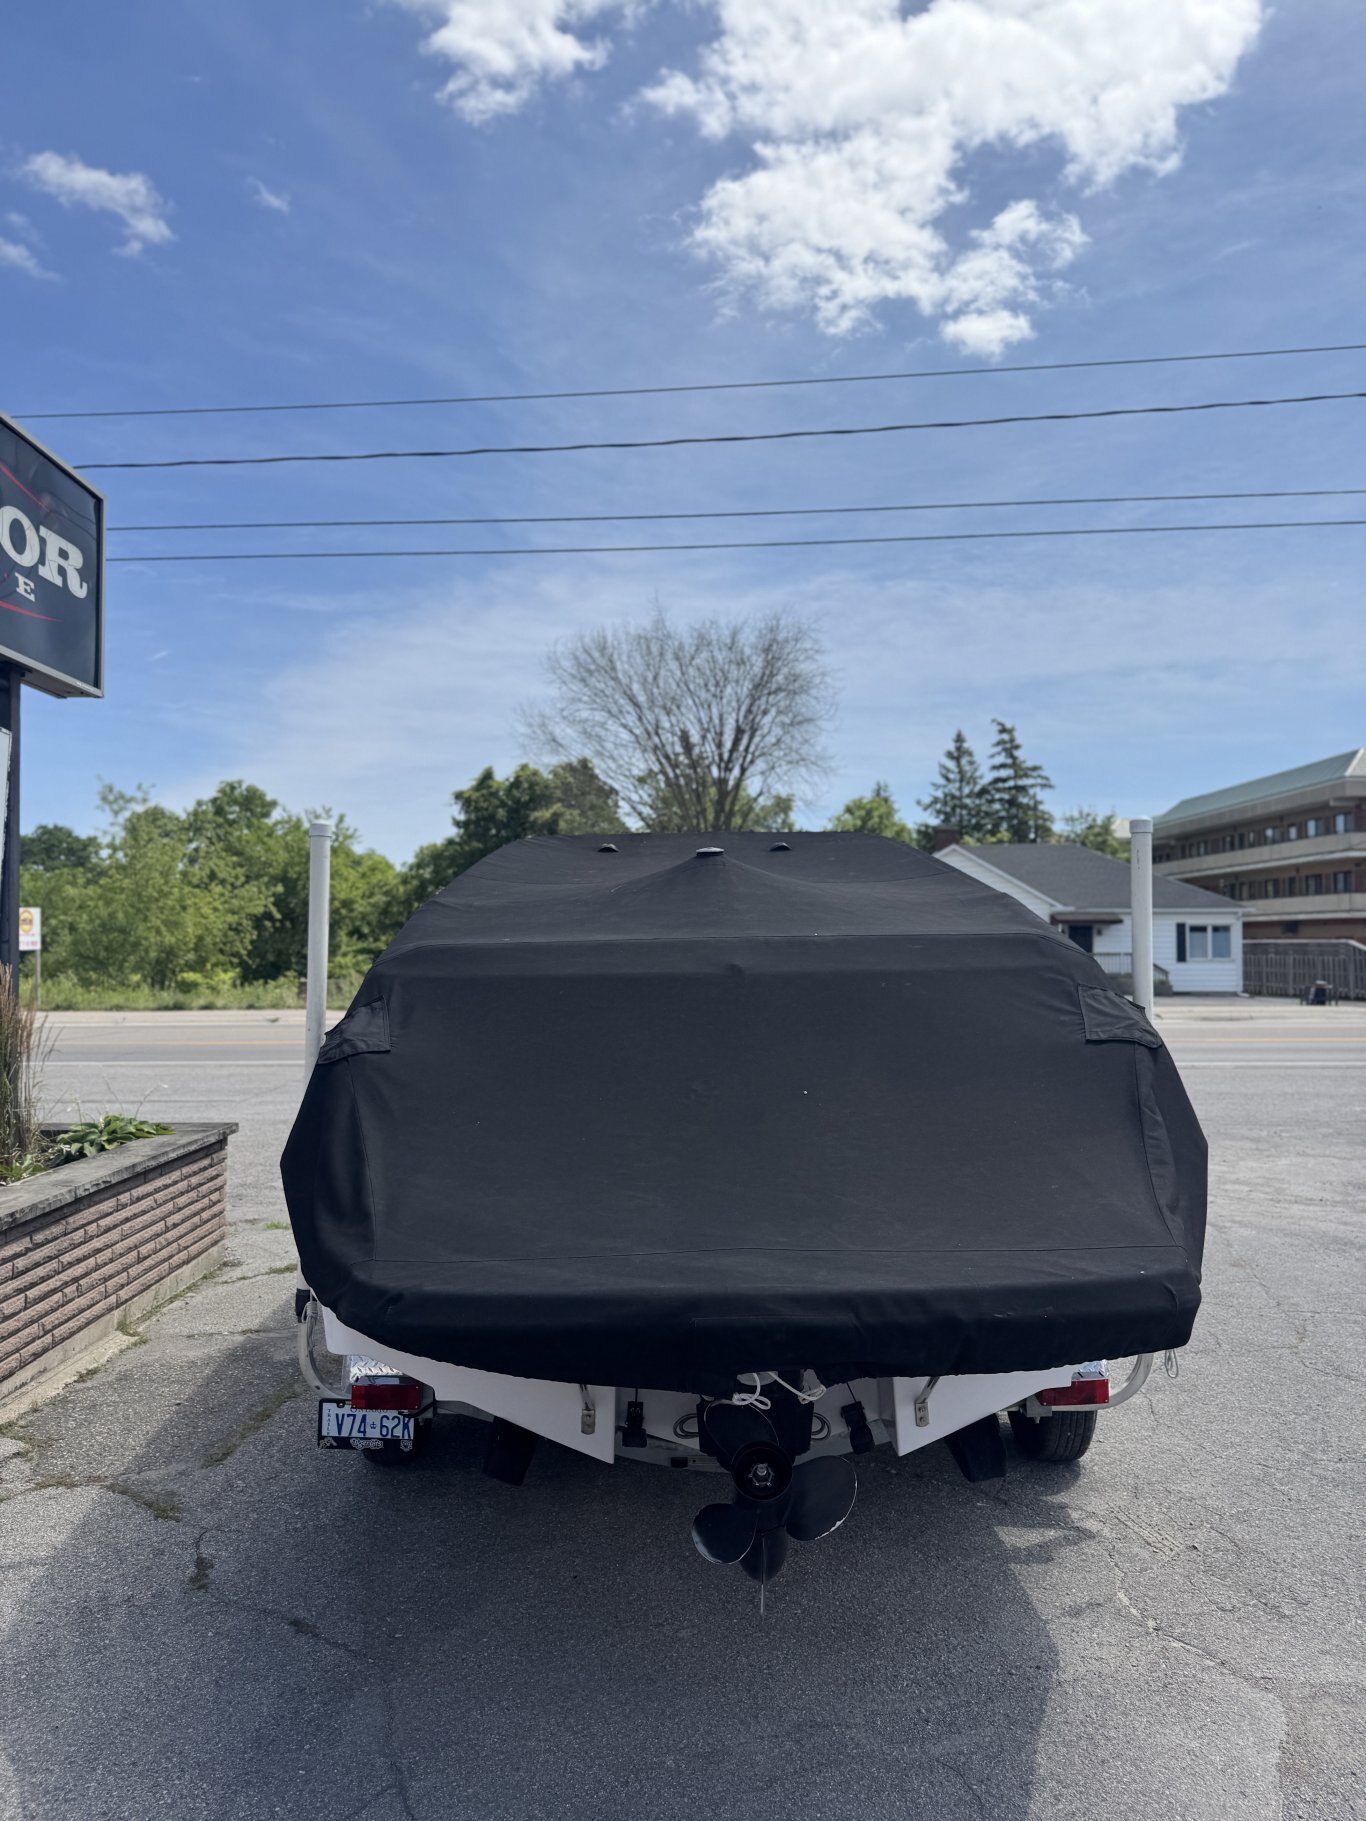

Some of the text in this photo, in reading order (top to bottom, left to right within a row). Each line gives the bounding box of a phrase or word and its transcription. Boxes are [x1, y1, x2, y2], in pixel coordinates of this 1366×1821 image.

[15, 571, 35, 602] E
[336, 1413, 411, 1439] V74 62K
